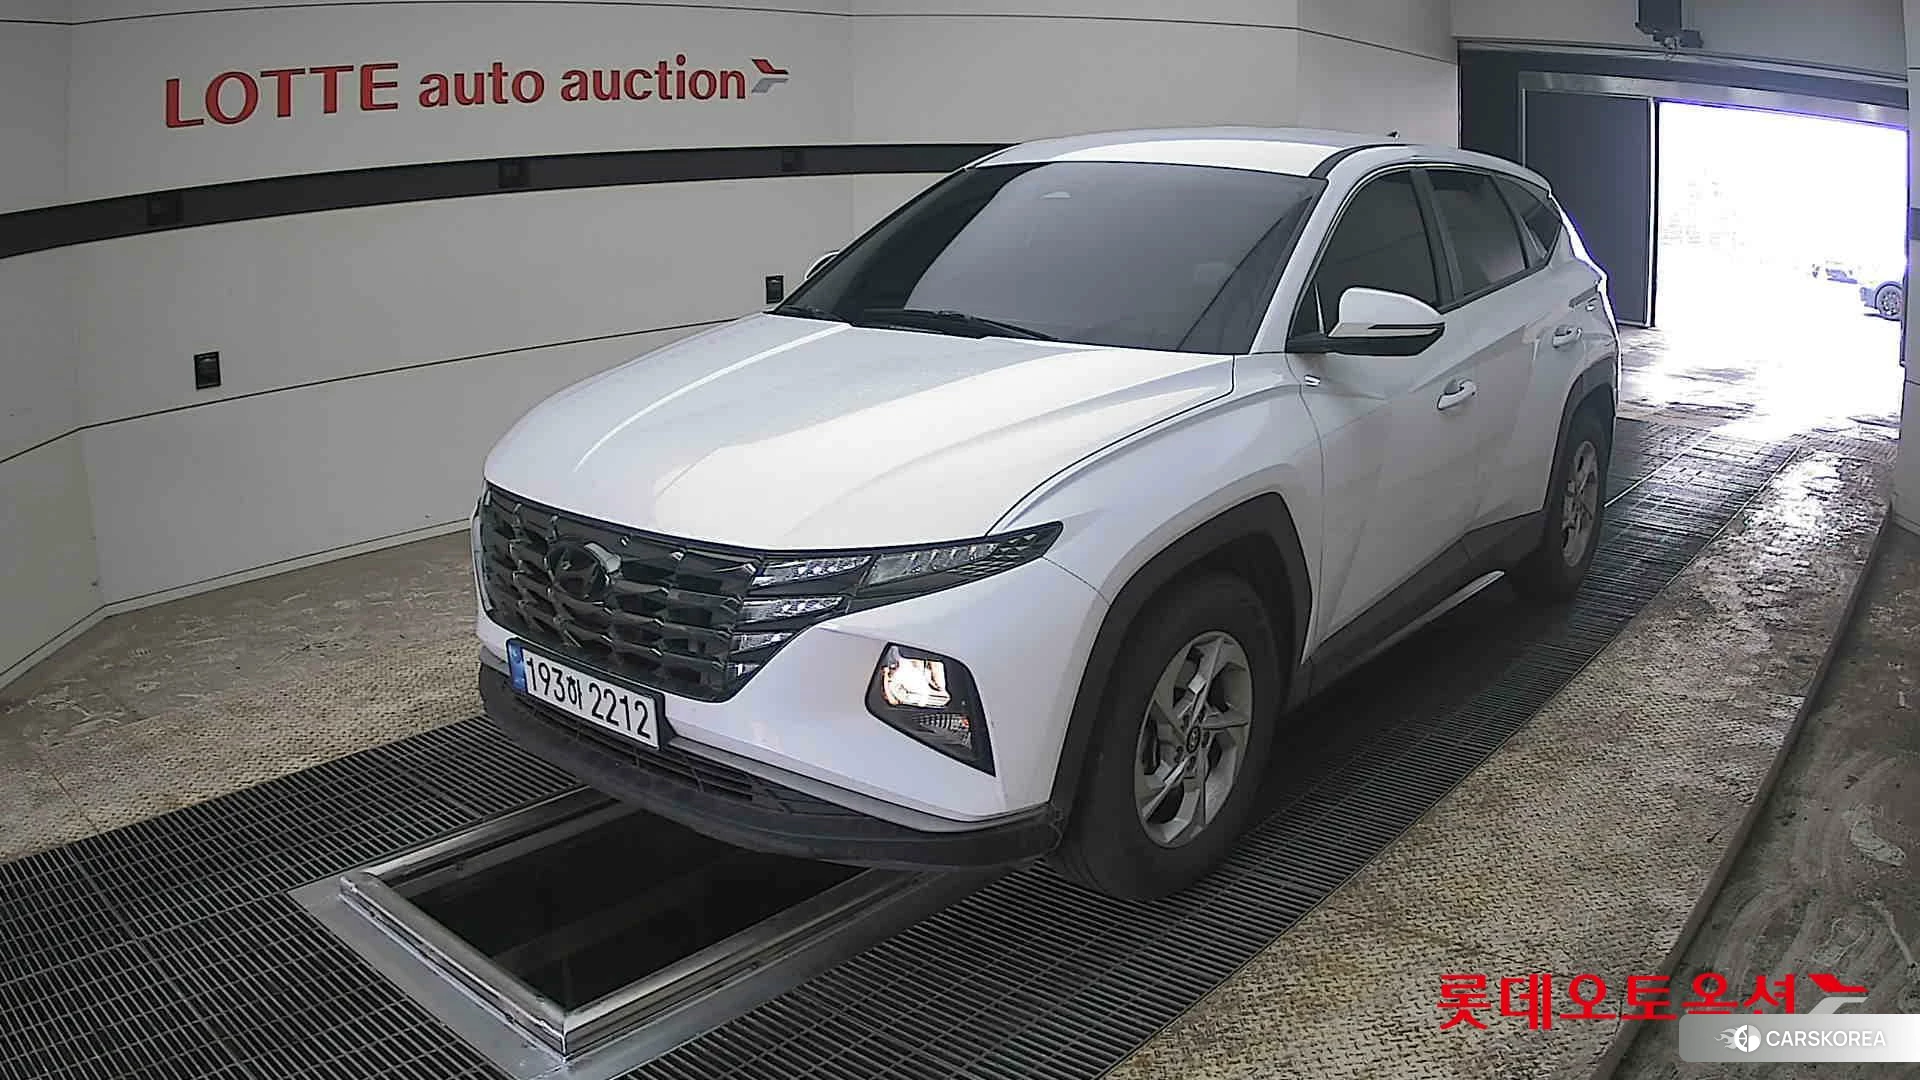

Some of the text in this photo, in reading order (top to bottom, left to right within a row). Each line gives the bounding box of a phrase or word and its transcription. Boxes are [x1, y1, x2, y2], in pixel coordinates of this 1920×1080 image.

[165, 54, 748, 128] LOTTE auto auction
[526, 657, 652, 739] 193하 2212
